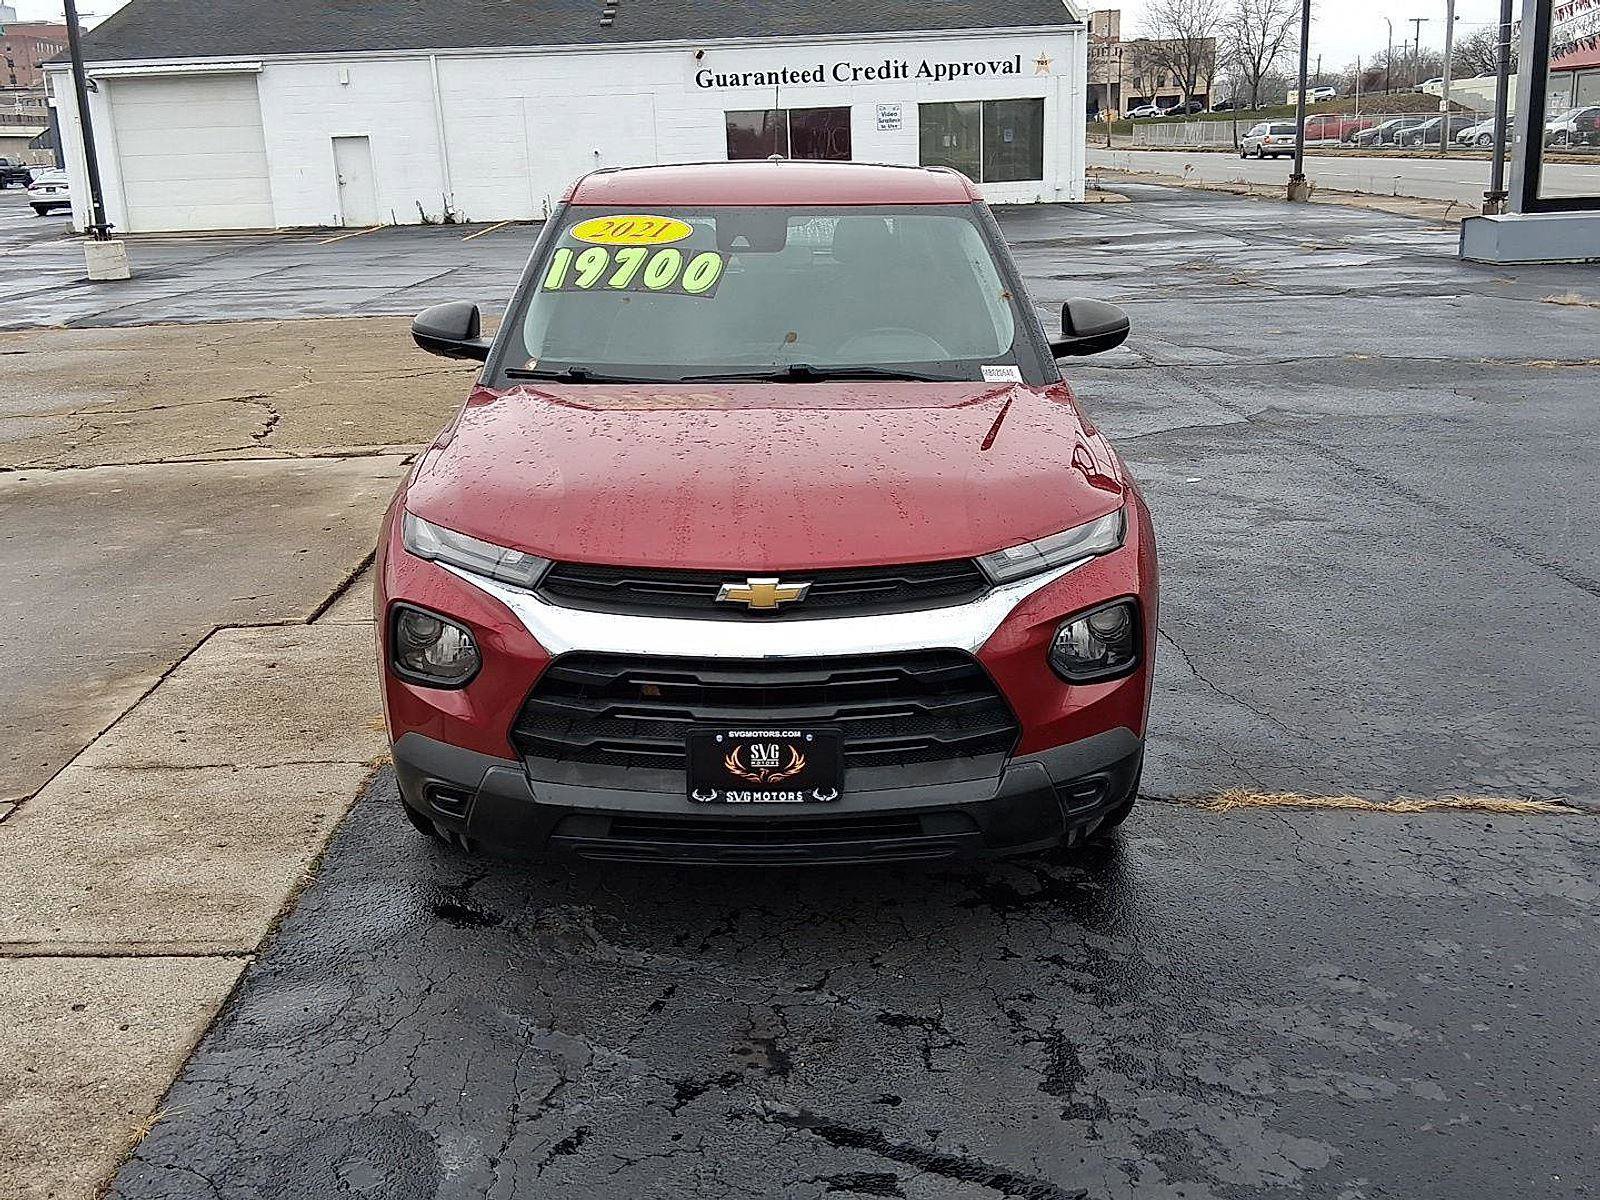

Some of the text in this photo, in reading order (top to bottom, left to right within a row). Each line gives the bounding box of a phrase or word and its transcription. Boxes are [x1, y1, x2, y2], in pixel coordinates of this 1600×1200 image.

[695, 55, 1021, 88] Guaranteed Credit Approval
[589, 221, 672, 238] 2021
[543, 247, 723, 294] 19700
[728, 730, 802, 738] SVGMOTORS.COM
[750, 742, 780, 761] SVG
[725, 790, 804, 803] SVG MOTORS
